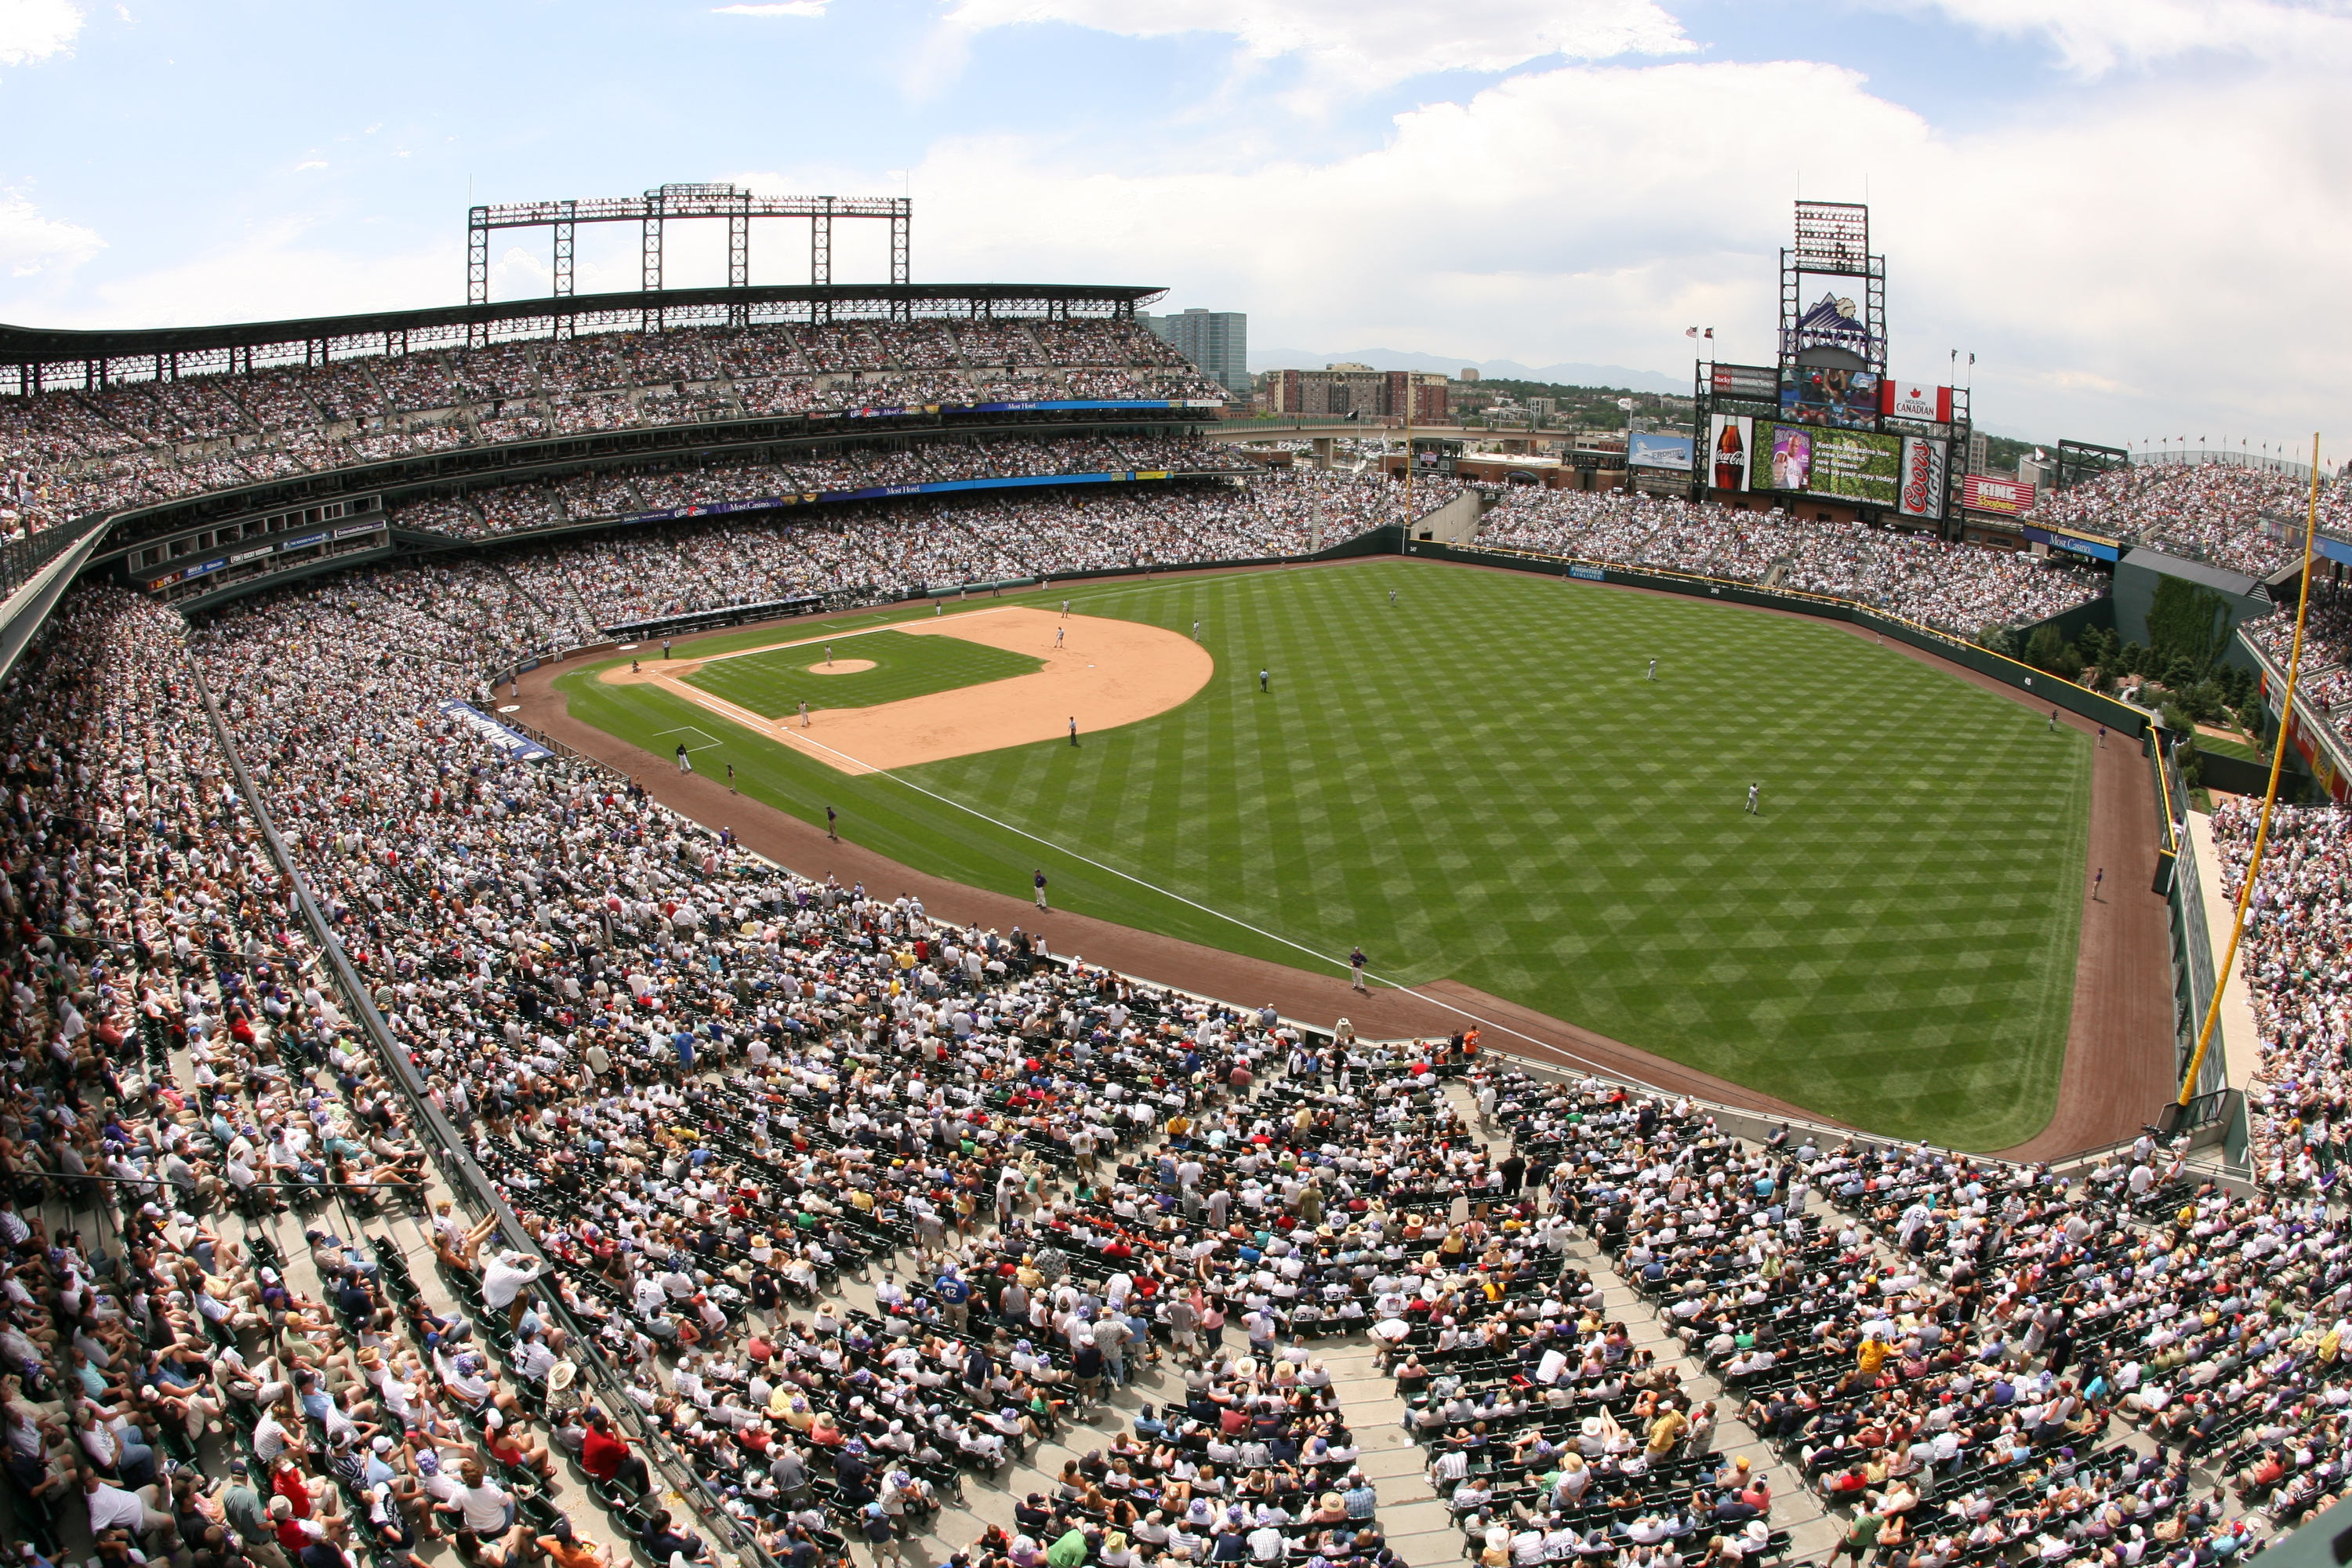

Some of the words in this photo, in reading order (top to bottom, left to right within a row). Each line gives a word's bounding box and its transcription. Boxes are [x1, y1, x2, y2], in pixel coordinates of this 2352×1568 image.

[1777, 328, 1886, 363] ROCKIES
[1896, 403, 1934, 416] CANADIAN
[1652, 448, 1686, 459] FRONTIER
[1816, 441, 1842, 451] Rockies
[1844, 445, 1875, 456] Magazine
[1830, 460, 1859, 470] features.
[1875, 476, 1897, 485] today!
[1904, 441, 1930, 514] Coors
[1926, 447, 1944, 517] LIGHT
[886, 486, 902, 495] Most
[1977, 482, 2017, 500] KING
[1976, 495, 2017, 510] Soopers
[2049, 534, 2067, 548] Most
[243, 551, 256, 560] ROCKY
[1571, 566, 1603, 576] FRONTIER
[1573, 572, 1601, 581] AIRLINES
[1914, 1210, 1927, 1221] 23
[640, 1288, 646, 1299] 2
[945, 1287, 957, 1298] 42
[905, 1356, 912, 1364] 2
[1251, 1453, 1255, 1464] 1
[1557, 1544, 1572, 1558] 13
